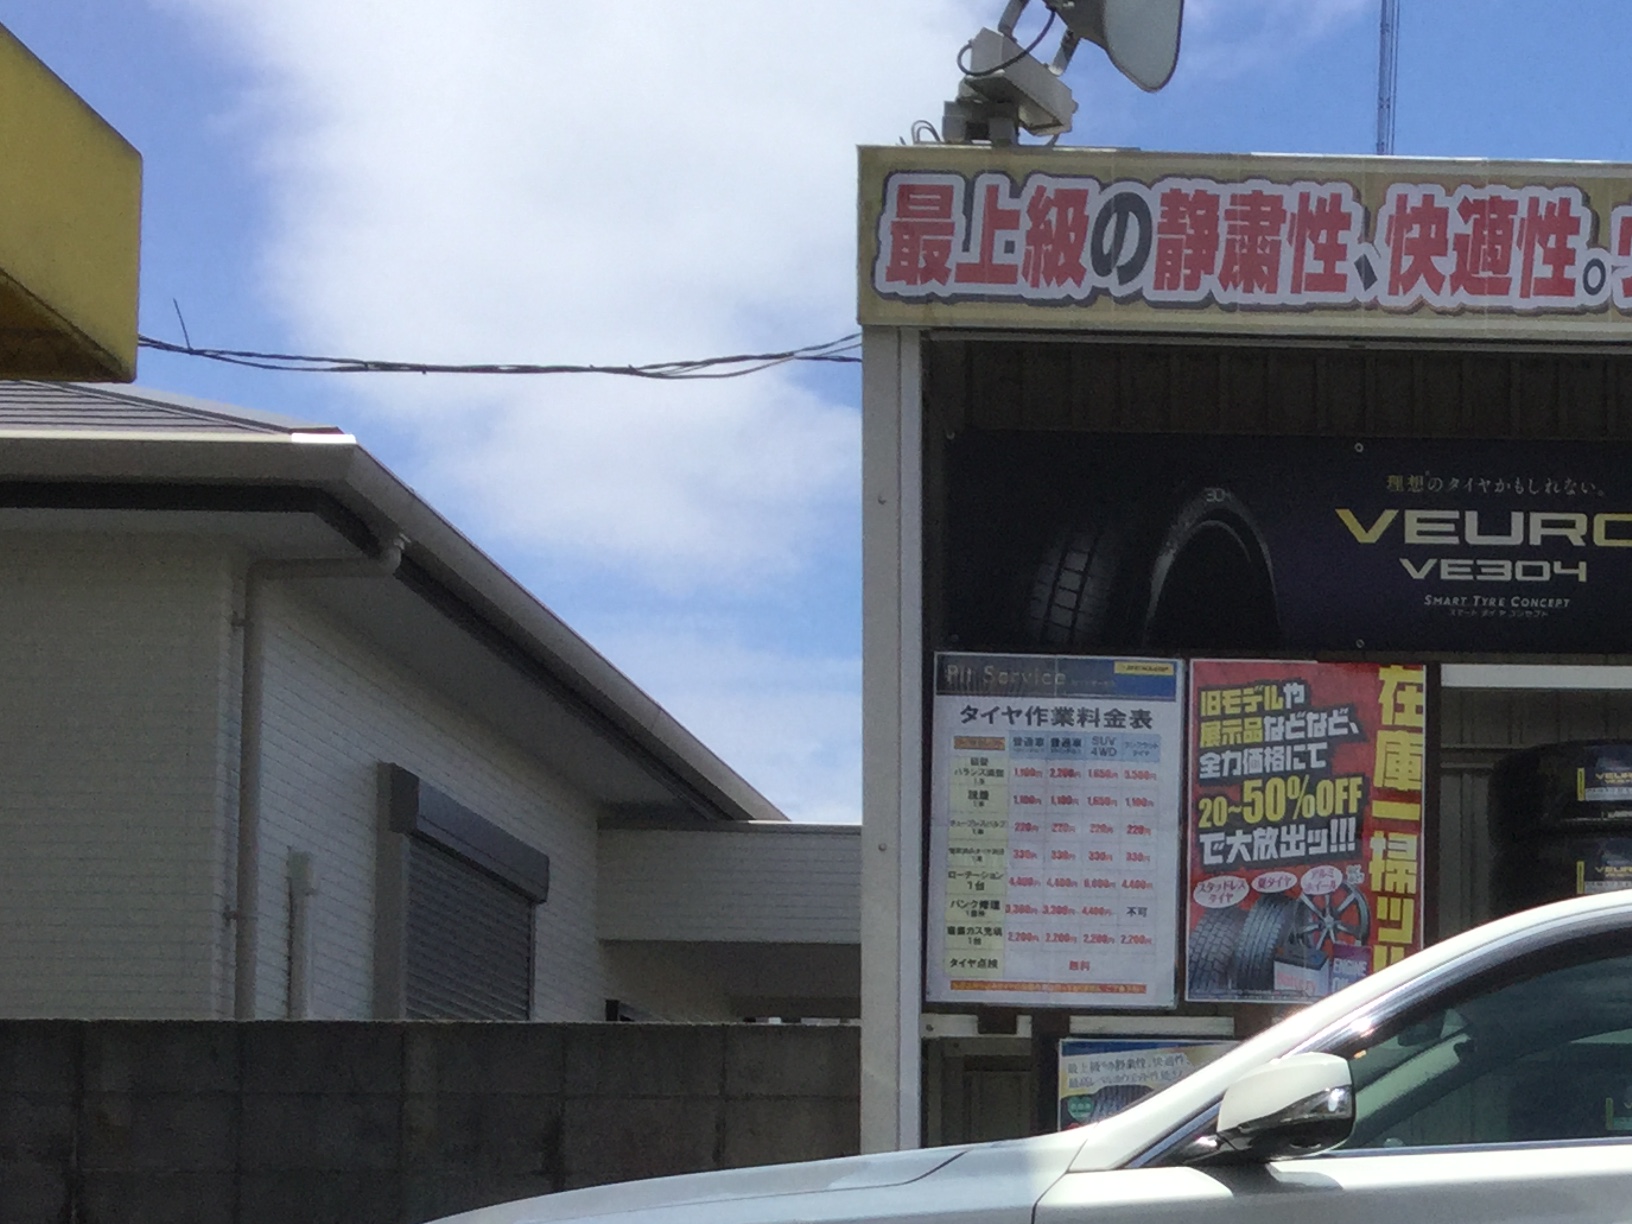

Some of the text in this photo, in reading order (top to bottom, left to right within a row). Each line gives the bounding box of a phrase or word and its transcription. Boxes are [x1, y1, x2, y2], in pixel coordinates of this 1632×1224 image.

[1399, 558, 1587, 582] VE304
[983, 665, 1066, 685] Service
[1201, 682, 1304, 716] 旧モデルや
[960, 705, 1153, 729] タイヤ作業料金表
[1200, 708, 1359, 748] 展示品などなど、
[1090, 747, 1117, 757] 4WD
[1092, 736, 1116, 746] SUV
[1199, 742, 1328, 779] 全力価格にて
[1126, 907, 1148, 918] 不可
